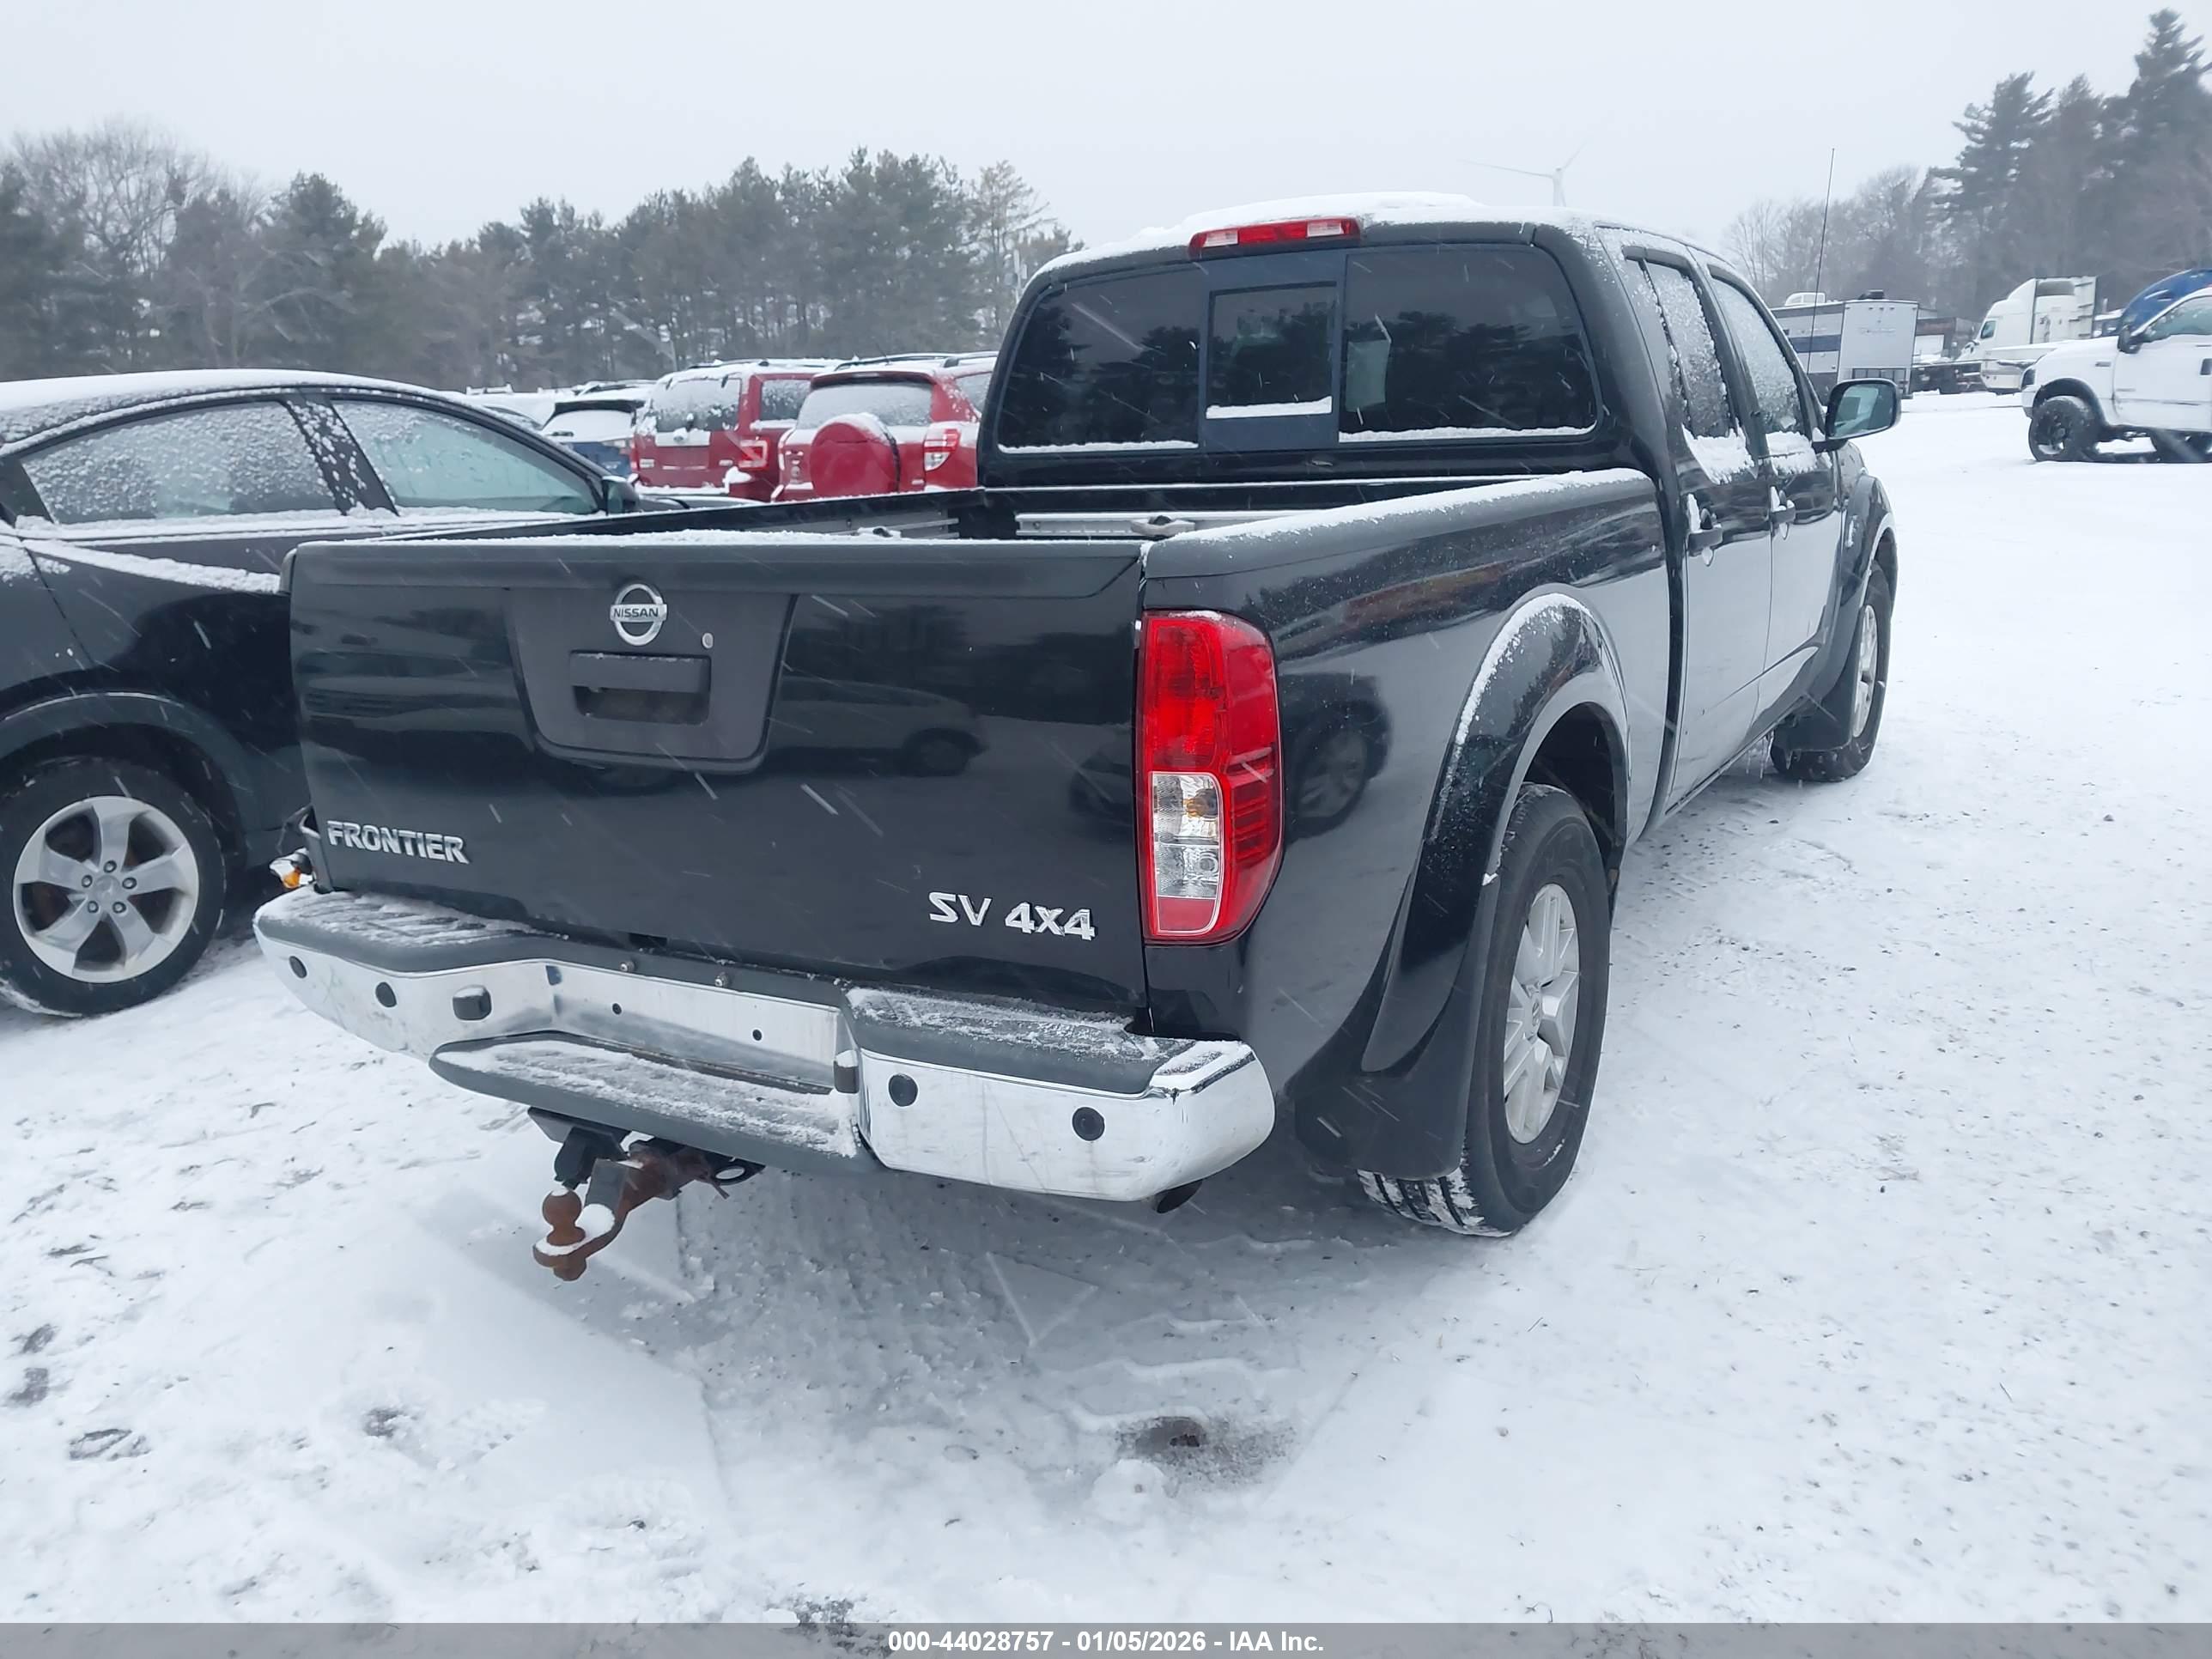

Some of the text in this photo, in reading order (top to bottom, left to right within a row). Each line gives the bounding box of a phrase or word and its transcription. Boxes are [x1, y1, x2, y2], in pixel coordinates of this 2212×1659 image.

[613, 607, 659, 618] NISSAN
[326, 820, 471, 865] FRONTIER
[928, 891, 992, 927] SV
